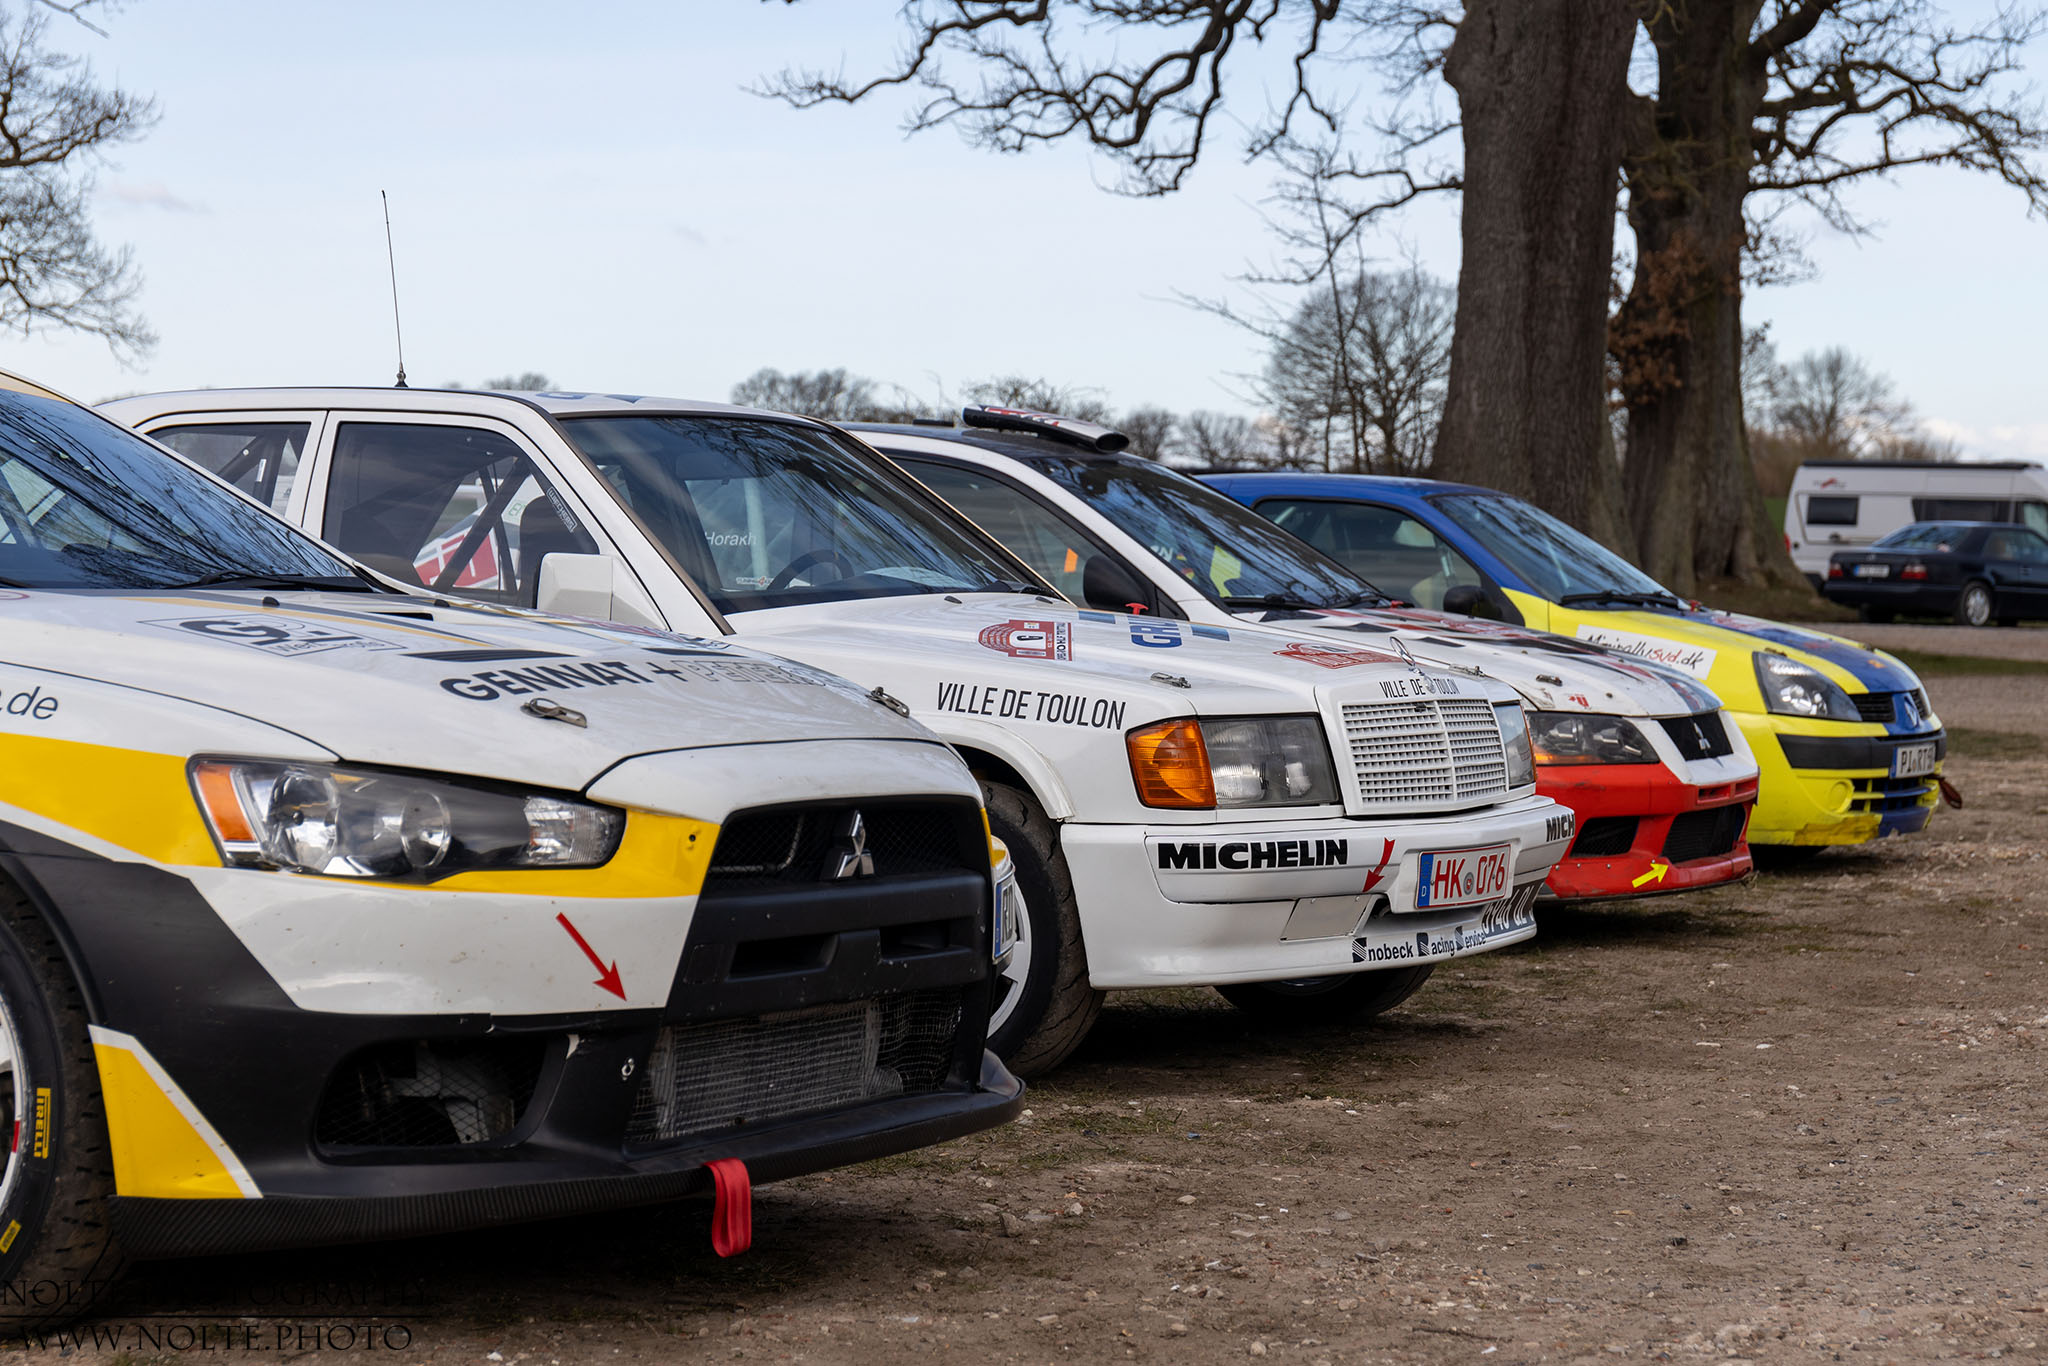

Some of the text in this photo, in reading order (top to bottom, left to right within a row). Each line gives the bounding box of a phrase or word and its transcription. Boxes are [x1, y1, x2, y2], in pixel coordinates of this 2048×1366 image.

[439, 661, 654, 701] GENNAT
[1379, 678, 1461, 699] VILLE DE TOULON
[937, 682, 1127, 731] VILLE DE TOULON
[1157, 838, 1348, 870] MICHELIN
[1434, 852, 1506, 900] HK 076
[34, 1088, 51, 1159] PIRELLI
